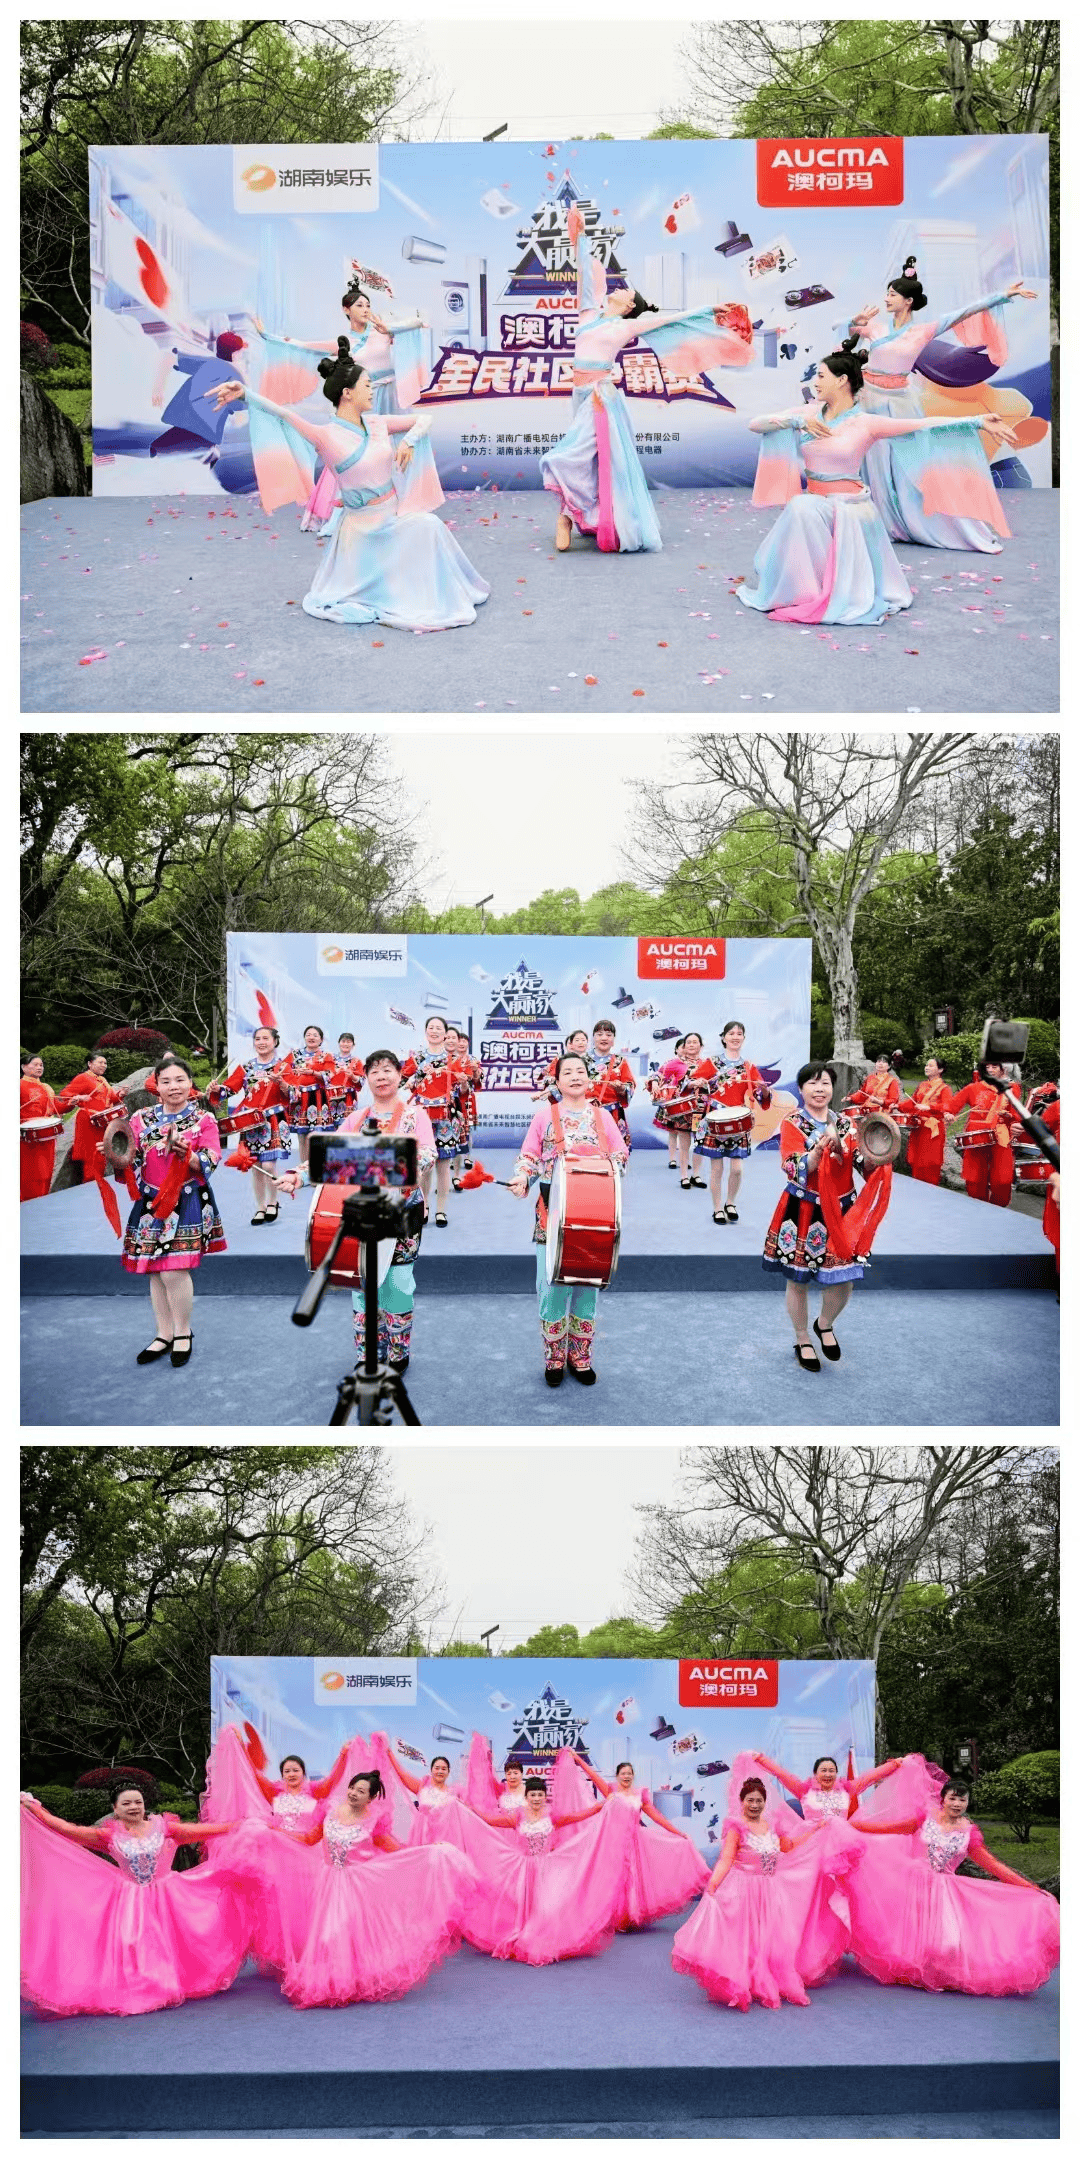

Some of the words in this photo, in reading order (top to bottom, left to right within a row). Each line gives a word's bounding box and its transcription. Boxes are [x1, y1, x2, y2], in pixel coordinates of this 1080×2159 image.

[771, 148, 890, 168] AUCMA
[278, 168, 372, 188] 湖南娱乐
[787, 172, 873, 191] 澳柯玛
[546, 271, 578, 282] WINN
[536, 298, 578, 310] AUC
[503, 315, 578, 347] 澳柯
[460, 446, 556, 456] 协办方：湖南省未来智
[345, 949, 403, 961] 湖南娱乐
[647, 944, 718, 956] AUCMA
[656, 958, 708, 970] 澳柯玛
[500, 972, 545, 991] 我是
[491, 990, 556, 1016] 大赢家
[508, 1015, 537, 1023] WINNER
[502, 1031, 544, 1039] AUCMA
[482, 1042, 563, 1061] 澳柯玛
[689, 1667, 768, 1680] AUCMA
[346, 1675, 412, 1688] 湖南娱乐
[700, 1683, 758, 1697] 澳柯玛
[525, 1699, 573, 1720] 我是
[513, 1720, 584, 1748] 大赢家
[533, 1749, 559, 1757] WINNE
[525, 1767, 556, 1776] AUC
